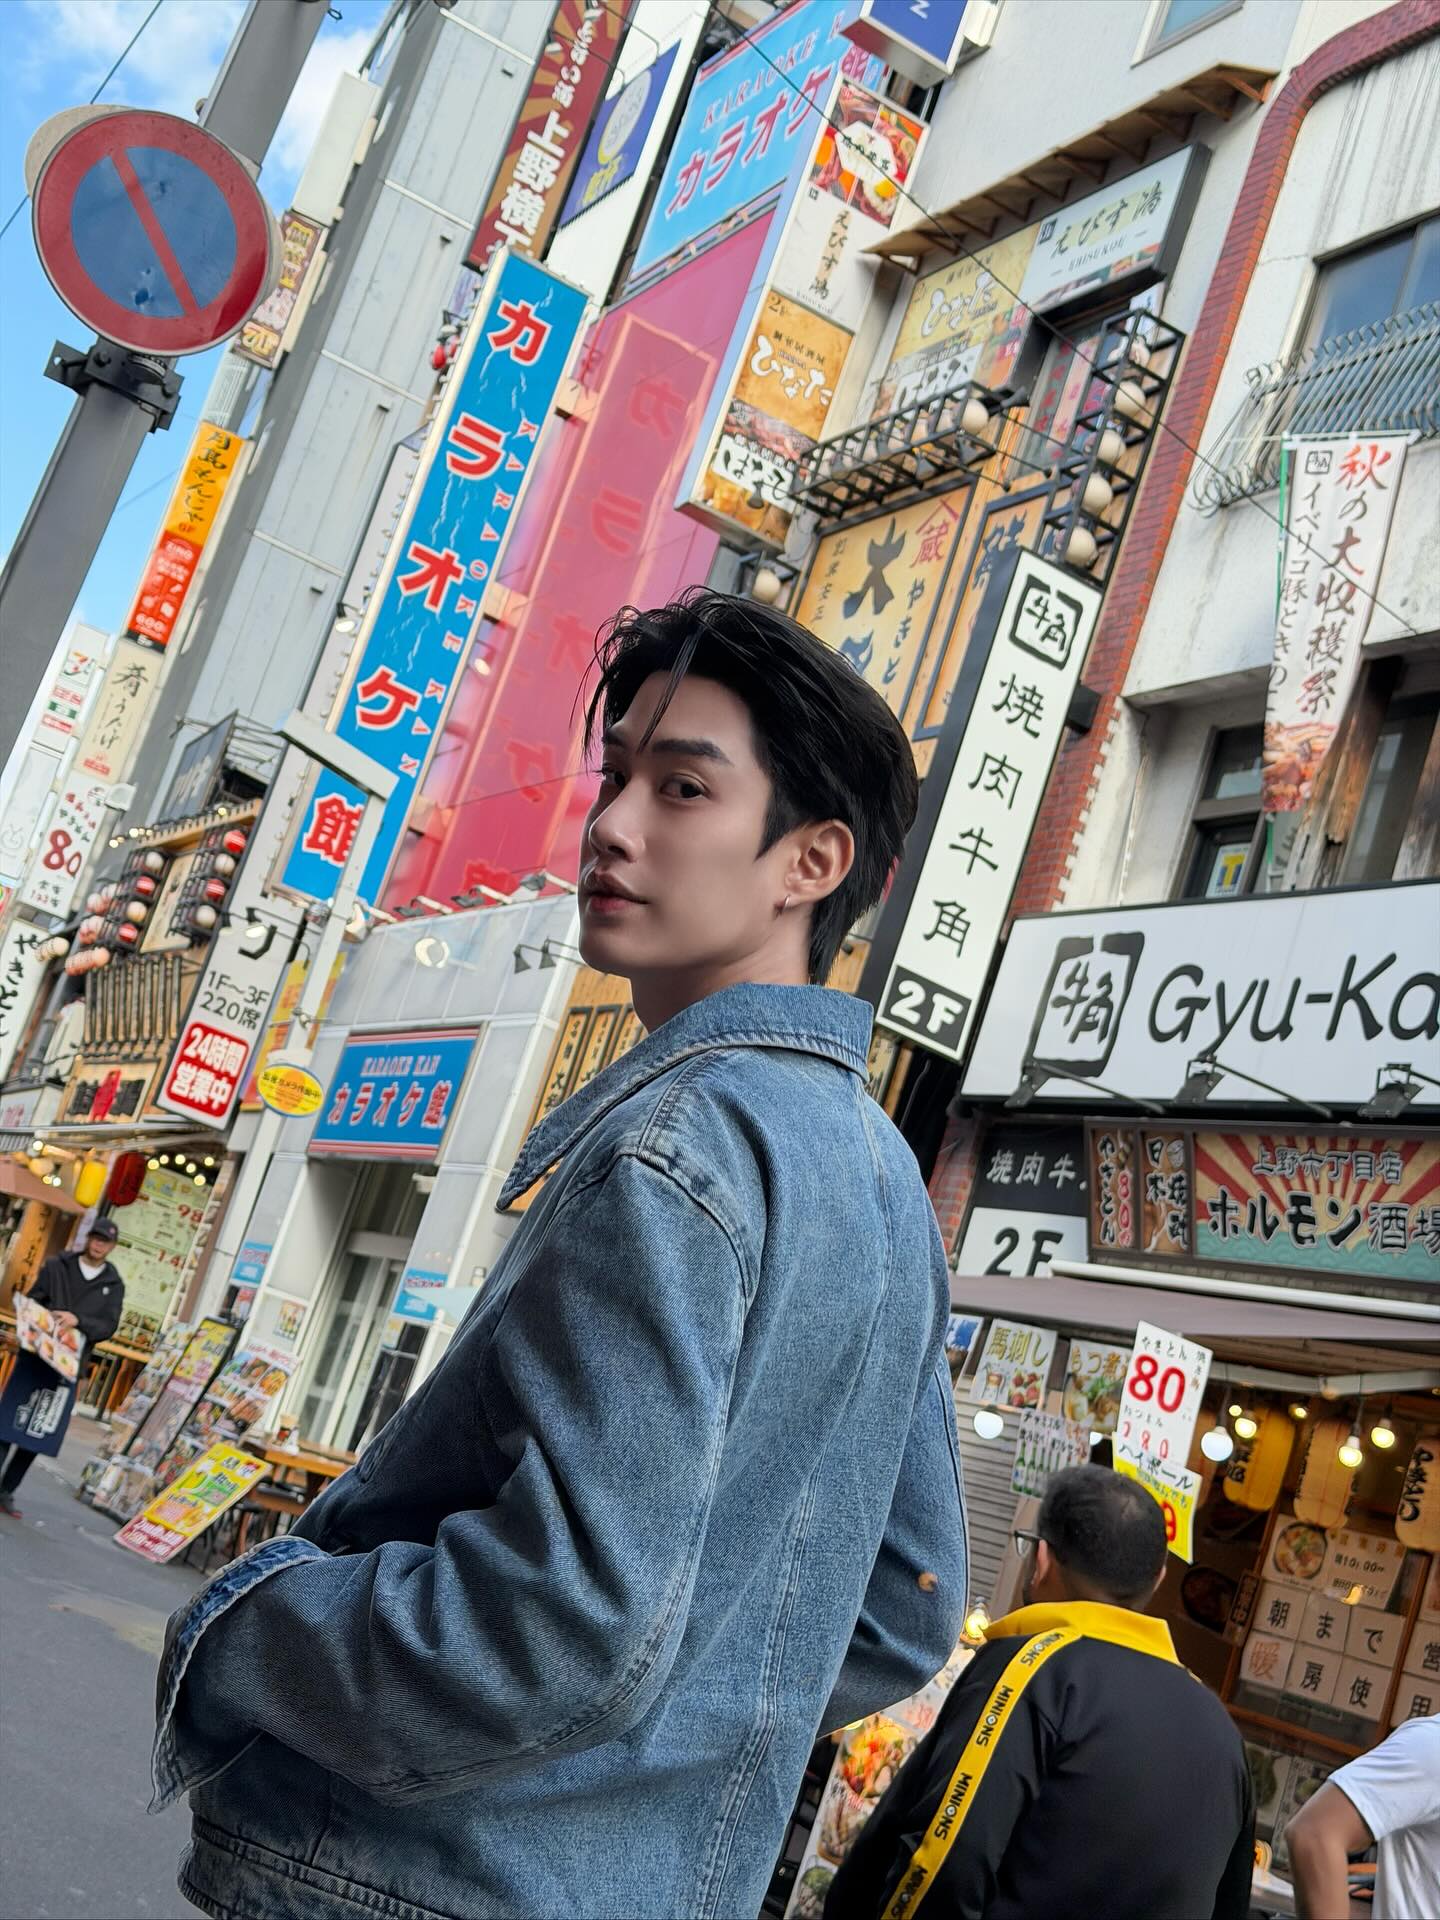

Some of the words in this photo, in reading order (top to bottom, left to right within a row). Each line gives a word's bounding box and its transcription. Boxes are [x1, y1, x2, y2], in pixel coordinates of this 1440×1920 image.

[441, 416, 538, 654] KARAOKE
[302, 297, 554, 868] カラオケ館
[1296, 444, 1391, 714] 秋の大収穫祭
[398, 678, 447, 779] KAN
[923, 673, 1044, 958] 焼肉牛角
[200, 991, 261, 1031] 220席
[897, 981, 963, 1034] 2F
[182, 1026, 248, 1076] 24時間
[360, 1055, 413, 1077] KARAOKE
[412, 1054, 442, 1076] KAN
[169, 1062, 233, 1112] 営業中
[326, 1080, 452, 1129] カラオケ館
[986, 1150, 1088, 1190] 焼肉牛
[1253, 1144, 1404, 1185] 上野六丁目店
[986, 1326, 1048, 1369] 馬刺し
[1128, 1354, 1186, 1413] 80
[1117, 1444, 1195, 1491] ハイボール
[976, 1683, 1015, 1748] MINIONS
[934, 1771, 974, 1841] MINIONS
